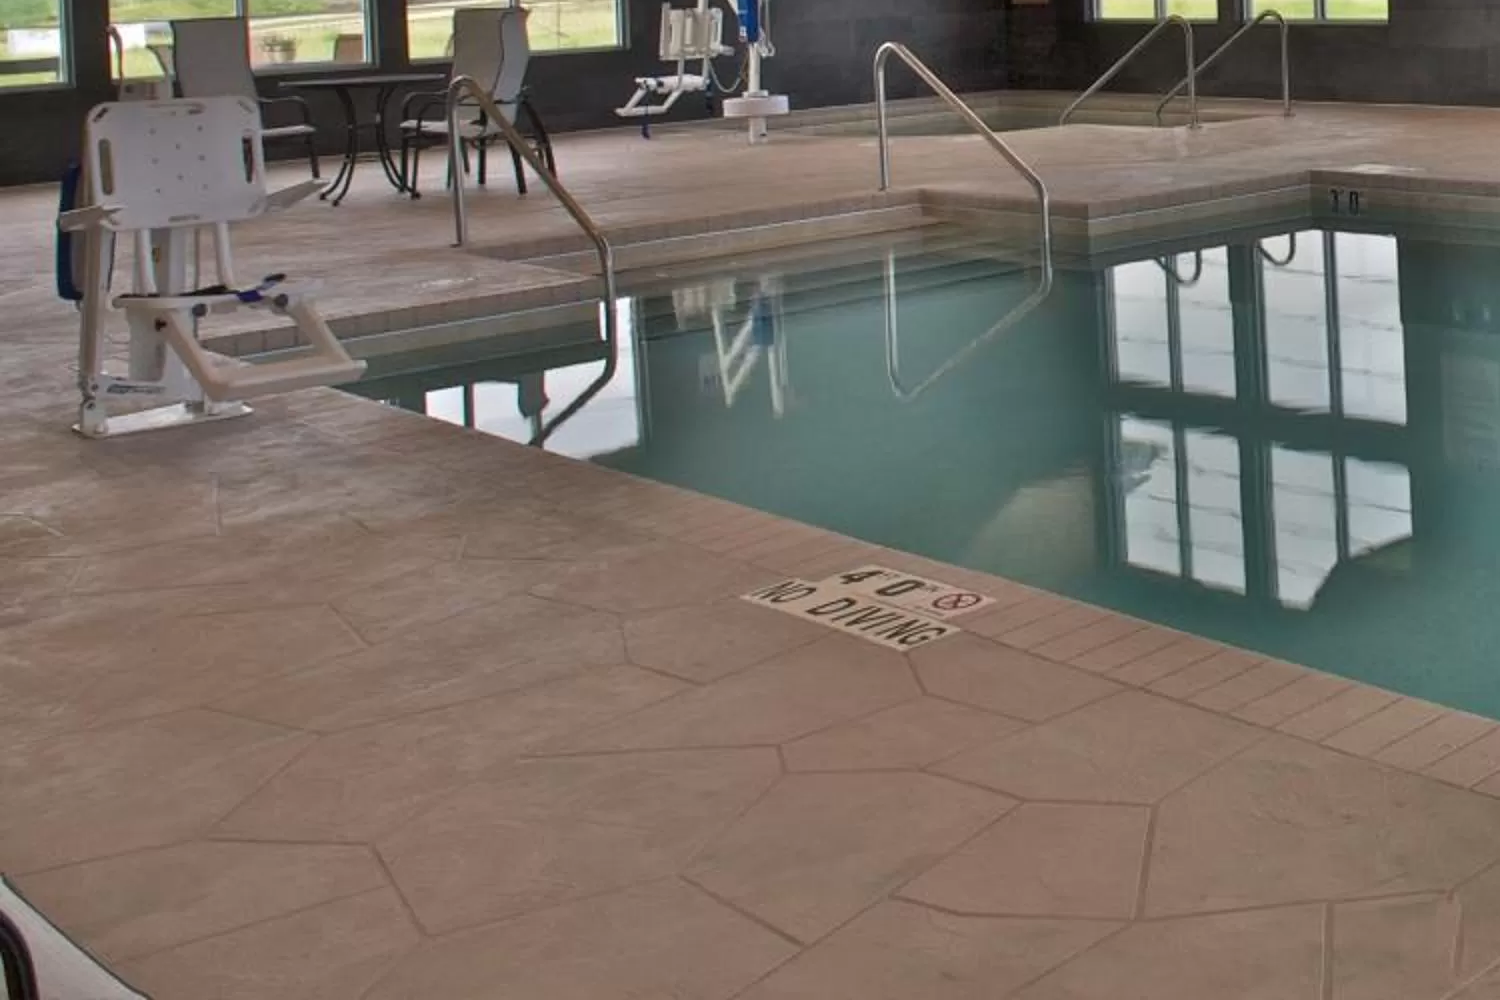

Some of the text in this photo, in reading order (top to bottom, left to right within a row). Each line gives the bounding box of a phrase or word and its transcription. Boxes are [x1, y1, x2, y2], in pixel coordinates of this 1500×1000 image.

[840, 570, 884, 585] 4
[875, 579, 926, 596] 0
[752, 581, 947, 646] NO DIVING
